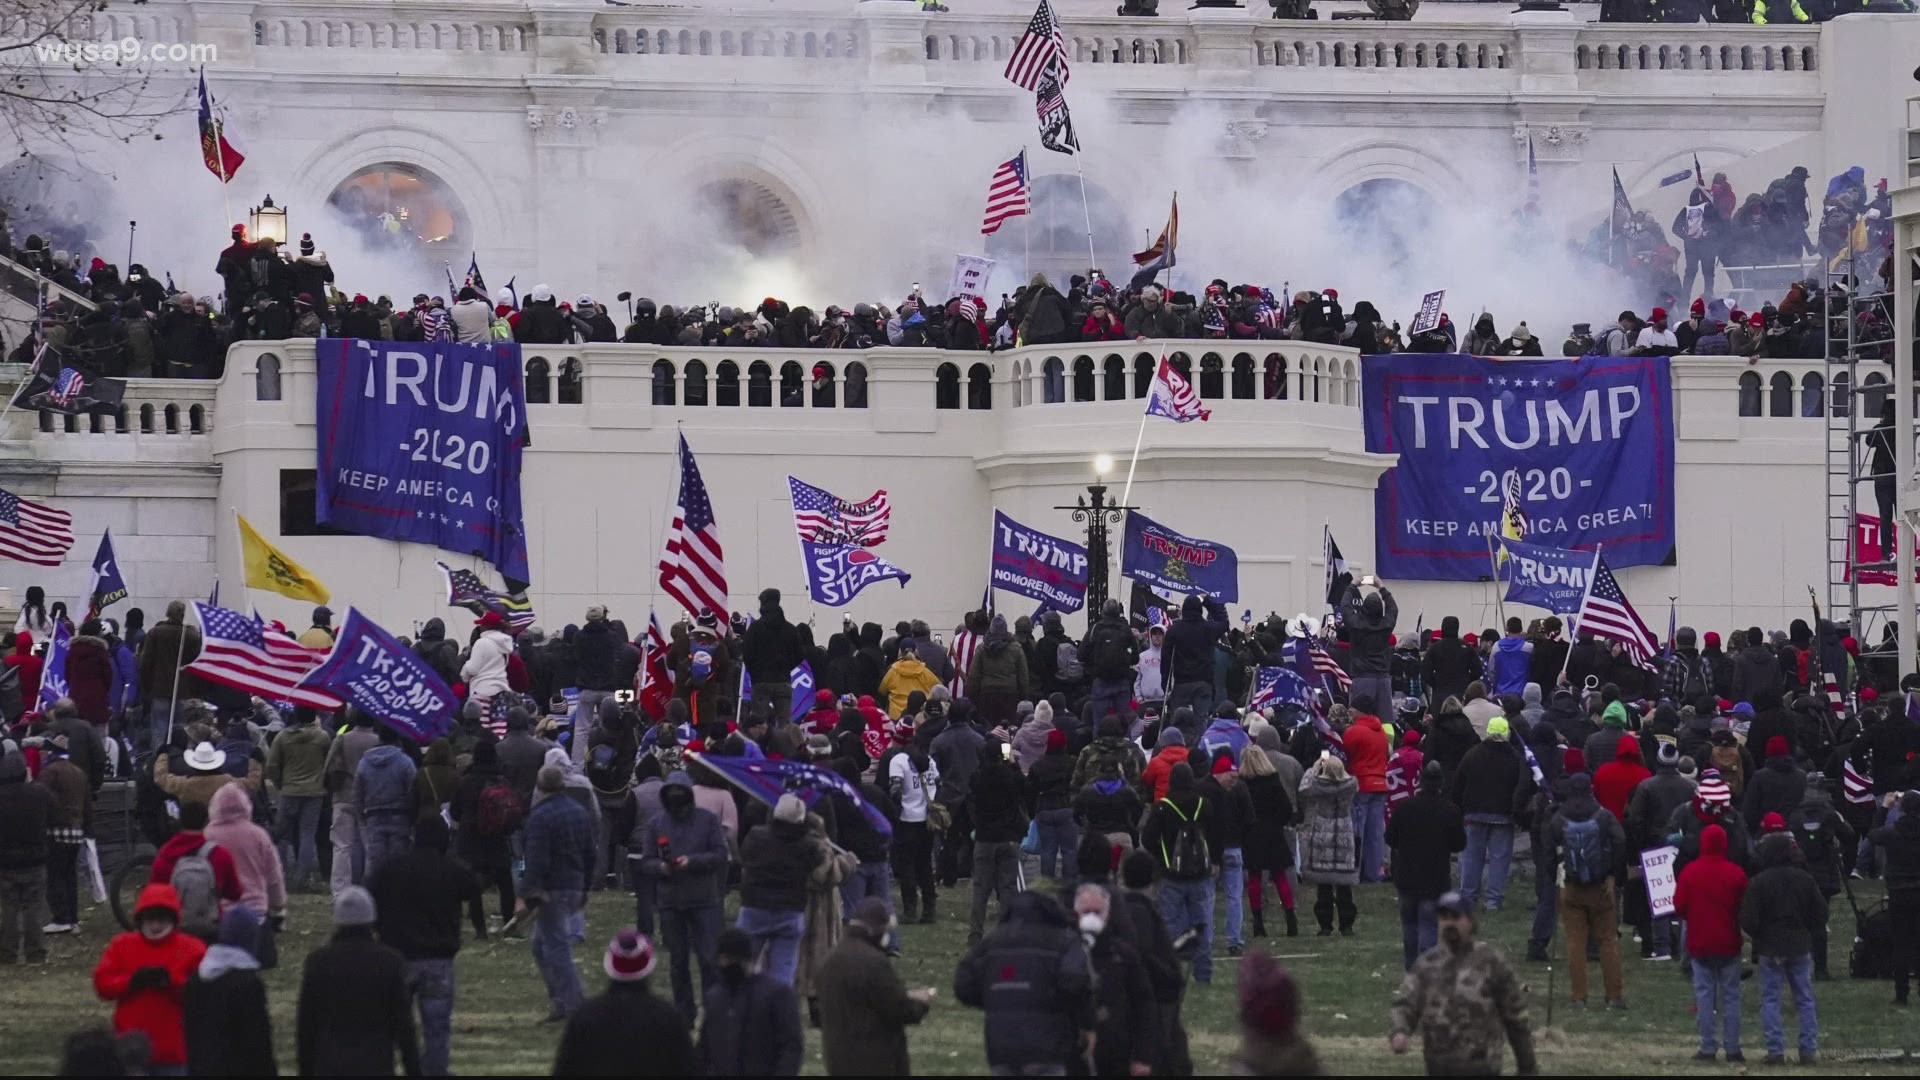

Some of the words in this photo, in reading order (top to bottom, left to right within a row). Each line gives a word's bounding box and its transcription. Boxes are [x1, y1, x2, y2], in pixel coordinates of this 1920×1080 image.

[1426, 292, 1442, 328] TRUMP
[1398, 385, 1641, 450] TRUMP
[338, 467, 389, 491] KEEP
[396, 479, 474, 507] AMECA
[837, 500, 878, 516] GUNS
[1406, 518, 1459, 536] KEEP
[1467, 518, 1568, 536] AMICA
[1577, 503, 1653, 529] GREAT!
[814, 546, 840, 556] FIGHT
[1000, 521, 1088, 575] TRUMP
[1141, 531, 1217, 567] TRUMP
[1134, 569, 1156, 580] KEEP
[1157, 576, 1193, 590] AMERICA
[1555, 590, 1579, 598] GREAT
[1644, 854, 1669, 868] KEEP
